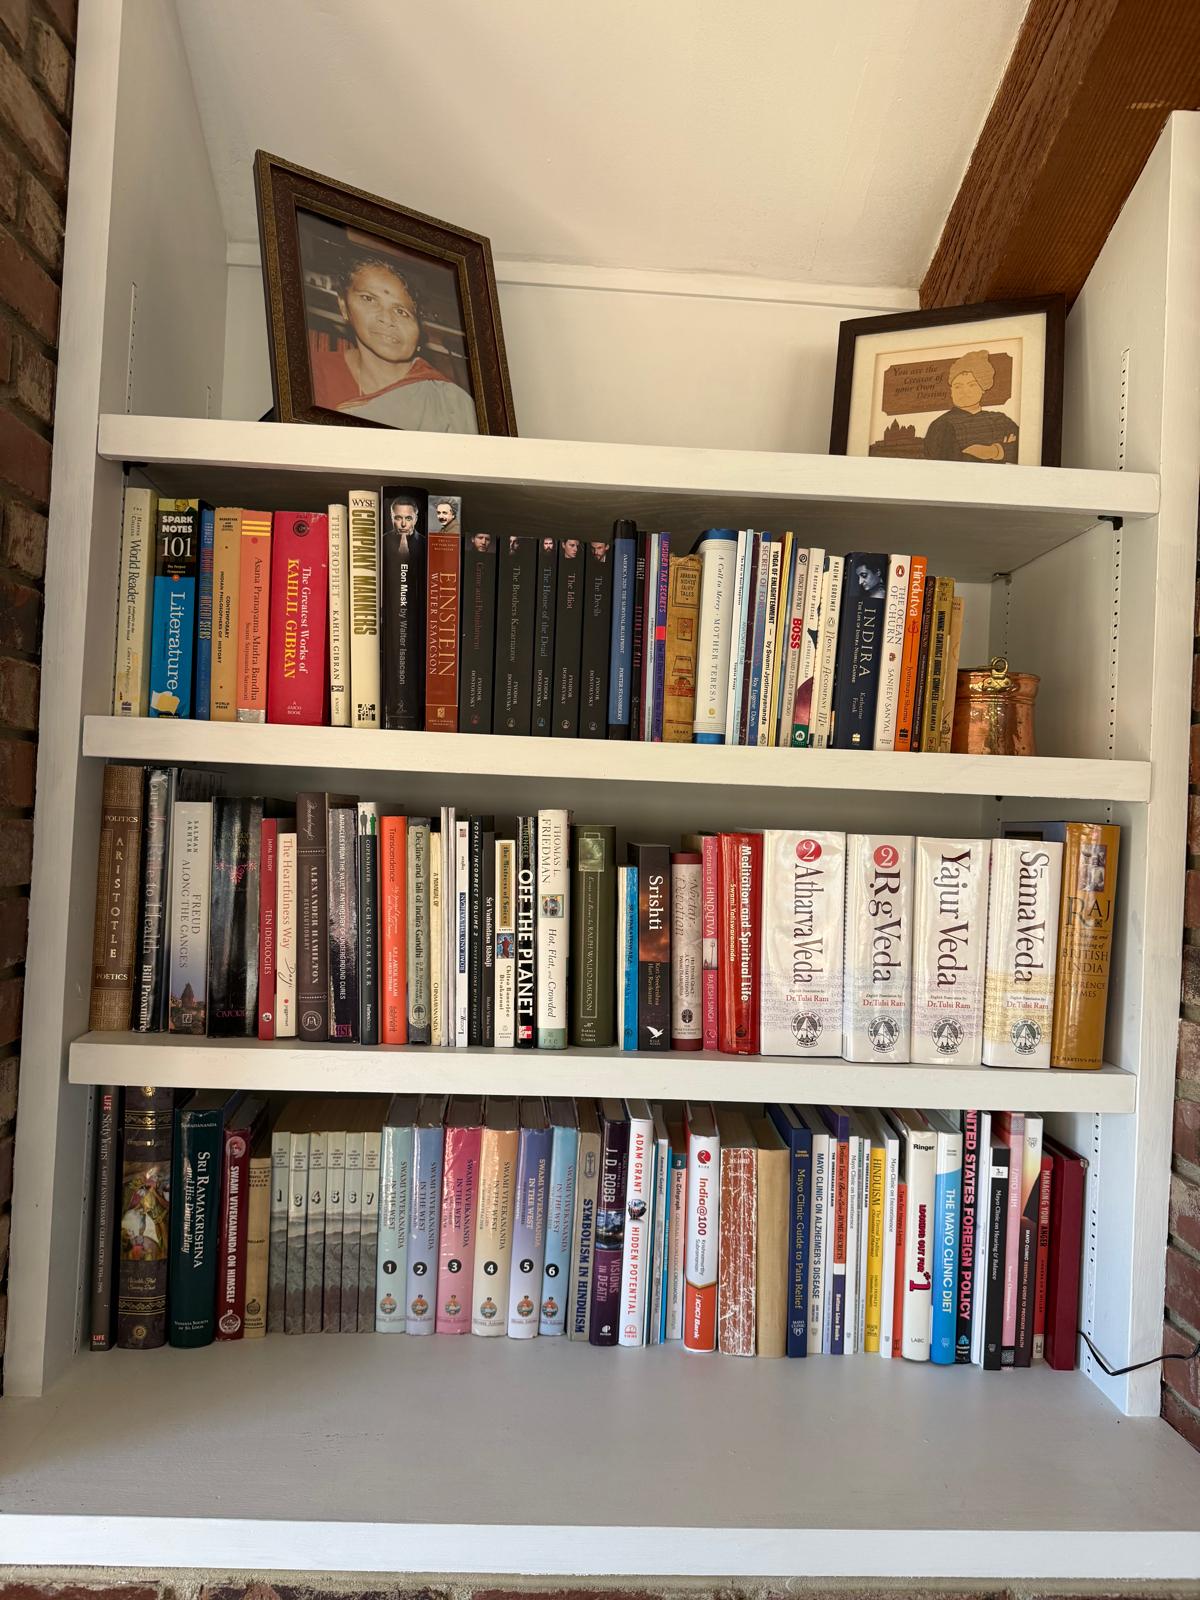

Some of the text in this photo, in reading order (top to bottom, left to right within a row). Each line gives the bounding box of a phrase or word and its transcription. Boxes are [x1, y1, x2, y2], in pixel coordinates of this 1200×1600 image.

[893, 367, 908, 377] You
[925, 366, 938, 374] the
[904, 377, 933, 385] Creator
[917, 391, 948, 399] Destiny
[162, 515, 193, 524] SPARK
[162, 524, 192, 533] NOTES
[352, 499, 375, 508] WYSE
[128, 540, 141, 604] World Reader
[161, 537, 192, 557] 101
[352, 510, 377, 635] COMPANY MANNERS
[400, 564, 408, 582] Elon
[400, 584, 408, 606] Musk
[660, 570, 668, 582] TAX
[909, 565, 924, 616] Hindutva
[166, 592, 185, 690] Literature
[218, 630, 222, 638] OF
[251, 557, 262, 700] Asana Pranayama Mudra Bandha
[284, 559, 299, 678] KAHLIL GIBRAN
[399, 608, 407, 619] by
[429, 573, 438, 675] WALTER ISAACSON
[438, 573, 456, 676] EINSTEIN
[791, 618, 803, 649] BOSS
[886, 586, 898, 644] OF CHURN
[895, 586, 906, 645] THE OCEAN
[399, 649, 407, 684] Isaacson
[710, 619, 721, 703] MOTHER TERESA
[858, 608, 876, 677] INDIRA
[851, 698, 859, 713] Frank
[858, 692, 866, 719] Katherine
[883, 669, 895, 734] SANJEEV SANYAL
[541, 819, 551, 884] FRIEDMAN
[802, 841, 815, 860] 2
[881, 847, 893, 867] 2
[280, 839, 292, 948] The Heartfulness Way
[649, 875, 663, 930] Srishti
[793, 863, 824, 939] Atharva
[933, 849, 971, 919] Yajur
[1017, 851, 1050, 923] Sāma
[1066, 896, 1110, 928] RAJ
[179, 859, 191, 968] ALONG THE GANGES
[192, 894, 202, 934] FREUD
[339, 928, 345, 936] OF
[740, 846, 751, 1001] Meditation and Spiritual Life
[264, 927, 272, 974] IDEOLOGIES
[518, 870, 532, 1016] OFF THE PLANET
[793, 939, 823, 984] Veda
[937, 922, 969, 988] Veda
[1015, 921, 1045, 984] Veda
[140, 965, 152, 1031] Bill Proxmire
[103, 1095, 112, 1110] LIFE
[604, 1173, 615, 1202] ROBB
[605, 1159, 615, 1168] D.
[816, 1153, 824, 1174] MAYO
[871, 1158, 882, 1206] HINDUISM
[193, 1152, 210, 1268] SRI RAMAKRISHNA
[226, 1166, 240, 1303] SWAMI VIVEKANANDA ON HIMSELF
[398, 1192, 406, 1248] VIVEKANANDA
[428, 1191, 436, 1249] VIVEKANANDA
[499, 1191, 509, 1249] VIVEKANANDA
[535, 1188, 544, 1247] VIVEKANANDA
[628, 1133, 644, 1315] ADAM GRANT HIDDEN POTENTIAL
[697, 1178, 709, 1235] India@100
[815, 1204, 822, 1214] ON
[1040, 1170, 1049, 1247] MANAGING YOUR ANGER
[794, 1169, 805, 1309] Mayo Clinic Guide to Pain Relief
[942, 1190, 955, 1313] THE MAYO CLINIC DIET
[960, 1154, 976, 1319] STATES FOREIGN POLICY
[416, 1265, 424, 1273] 2
[575, 1199, 592, 1333] SYMBOLISM IN HINDUISM
[610, 1260, 620, 1293] VISIONS
[812, 1267, 820, 1298] DISEASE
